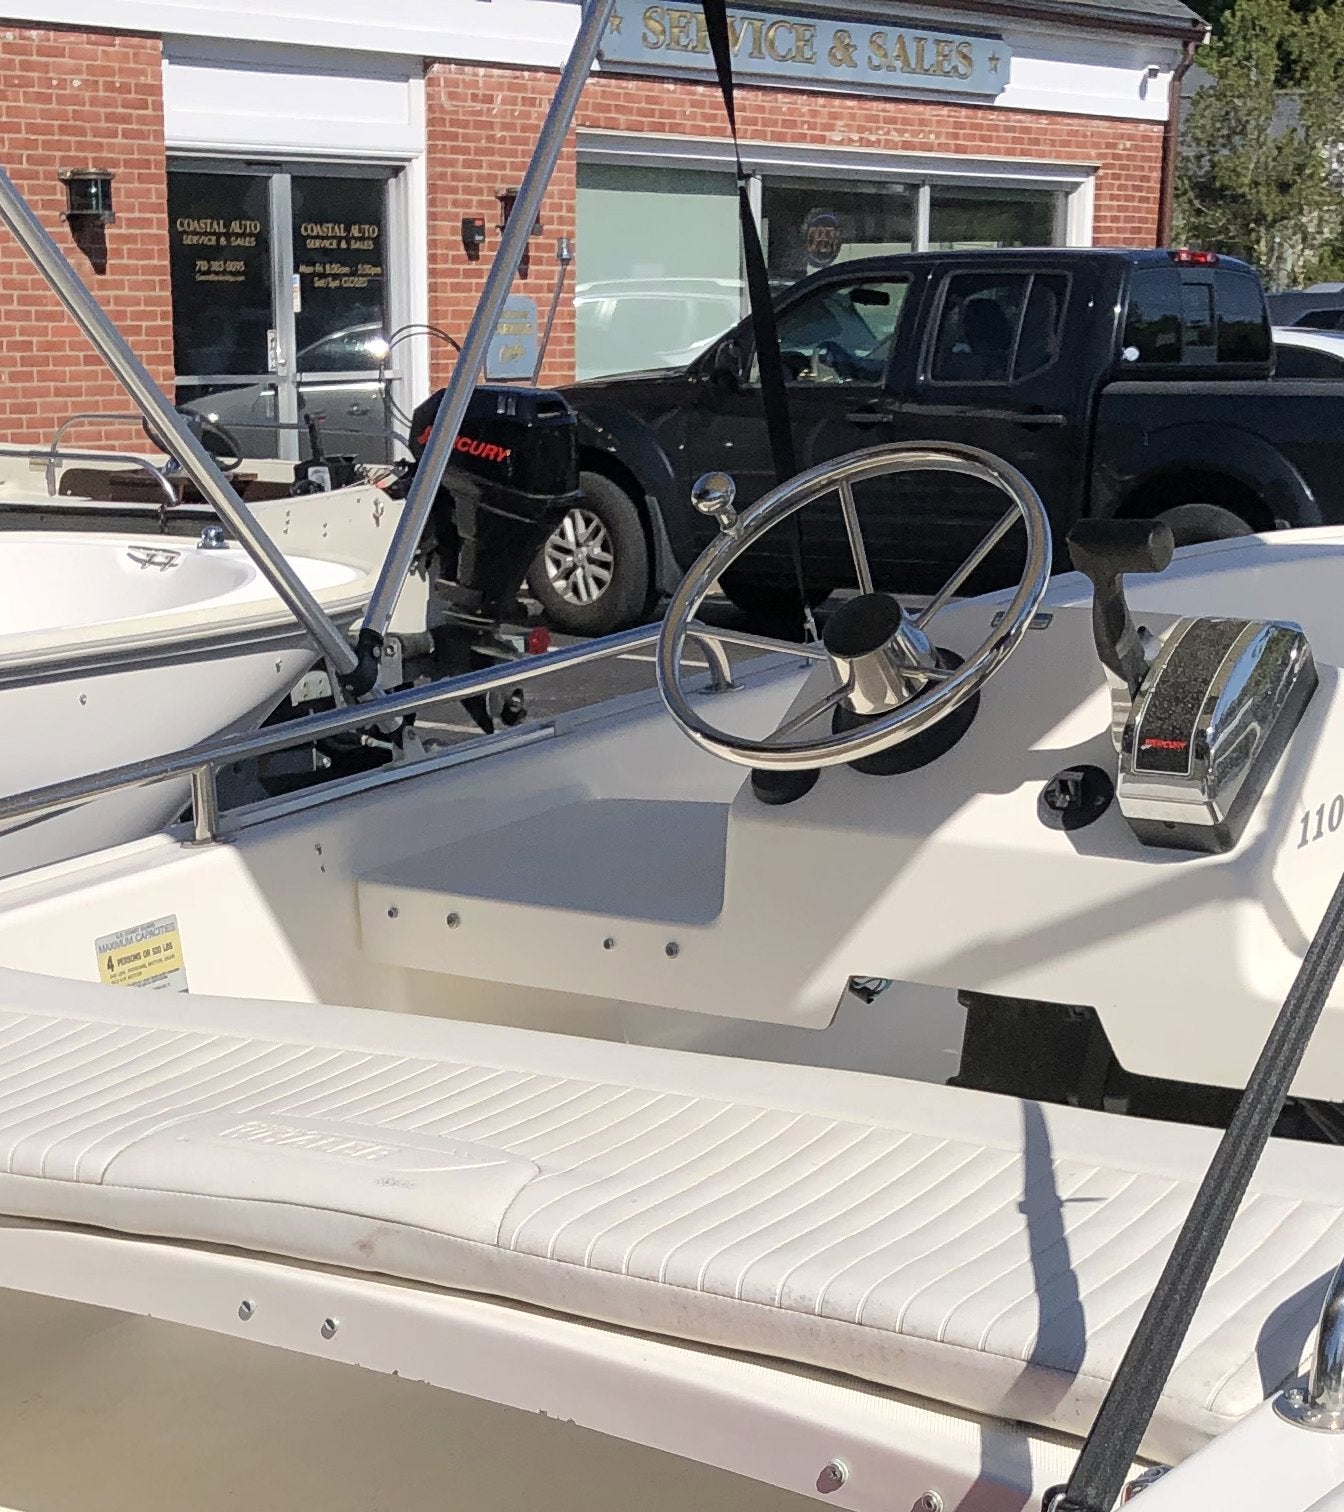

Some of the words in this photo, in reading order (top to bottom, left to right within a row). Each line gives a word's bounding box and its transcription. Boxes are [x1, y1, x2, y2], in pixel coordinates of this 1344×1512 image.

[827, 29, 858, 68] &
[867, 30, 974, 80] SALES
[176, 218, 226, 233] COASTAL
[230, 220, 260, 234] AUTO
[300, 223, 347, 237] COASTAL
[349, 224, 379, 238] AUTO
[182, 234, 217, 246] SERVICE
[230, 236, 256, 247] SALES
[306, 239, 337, 249] SERVICE
[351, 240, 374, 250] SALES
[417, 425, 511, 462] MCURY
[1297, 793, 1344, 850] 110
[98, 936, 134, 953] MAXIMUM
[106, 955, 115, 972] 4
[117, 952, 142, 967] PERSONS
